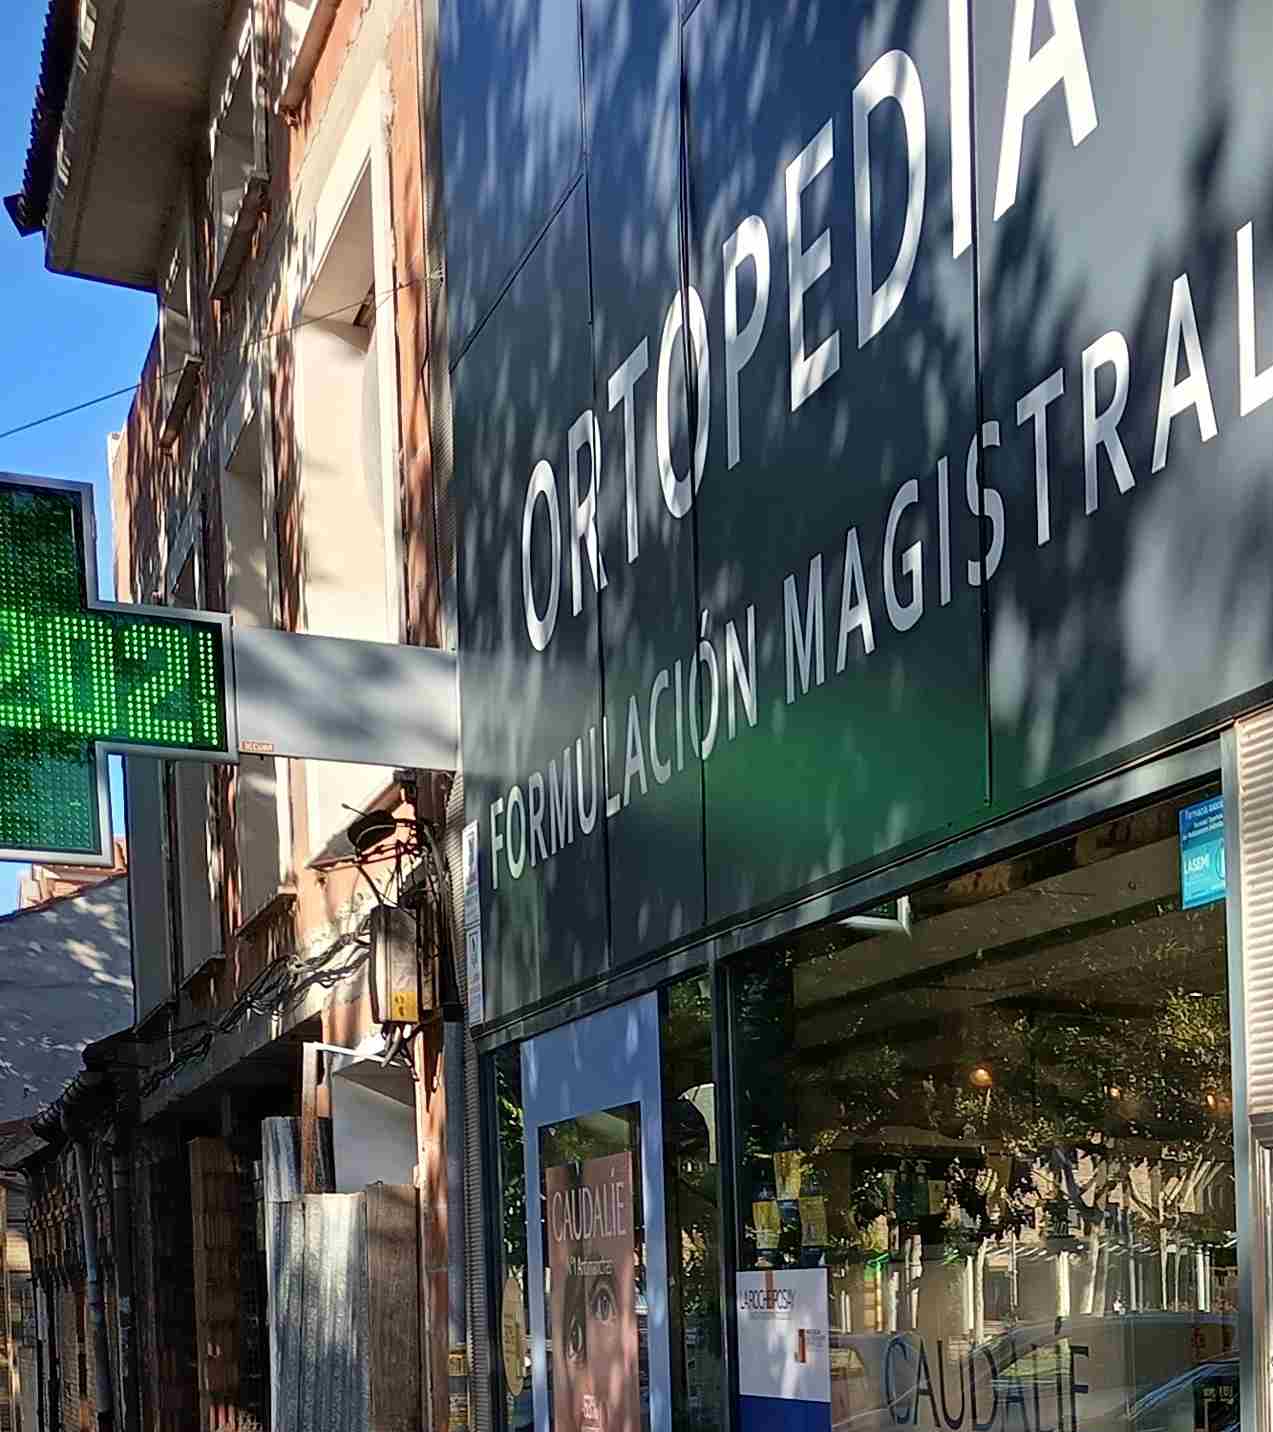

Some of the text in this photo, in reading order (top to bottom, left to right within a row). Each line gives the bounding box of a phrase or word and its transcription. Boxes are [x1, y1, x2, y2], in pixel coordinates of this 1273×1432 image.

[521, 0, 1098, 652] ORTOPEDIA
[0, 608, 219, 745] 202
[489, 603, 759, 891] FORMULACIÓN
[552, 1167, 627, 1242] CAUDALÍE
